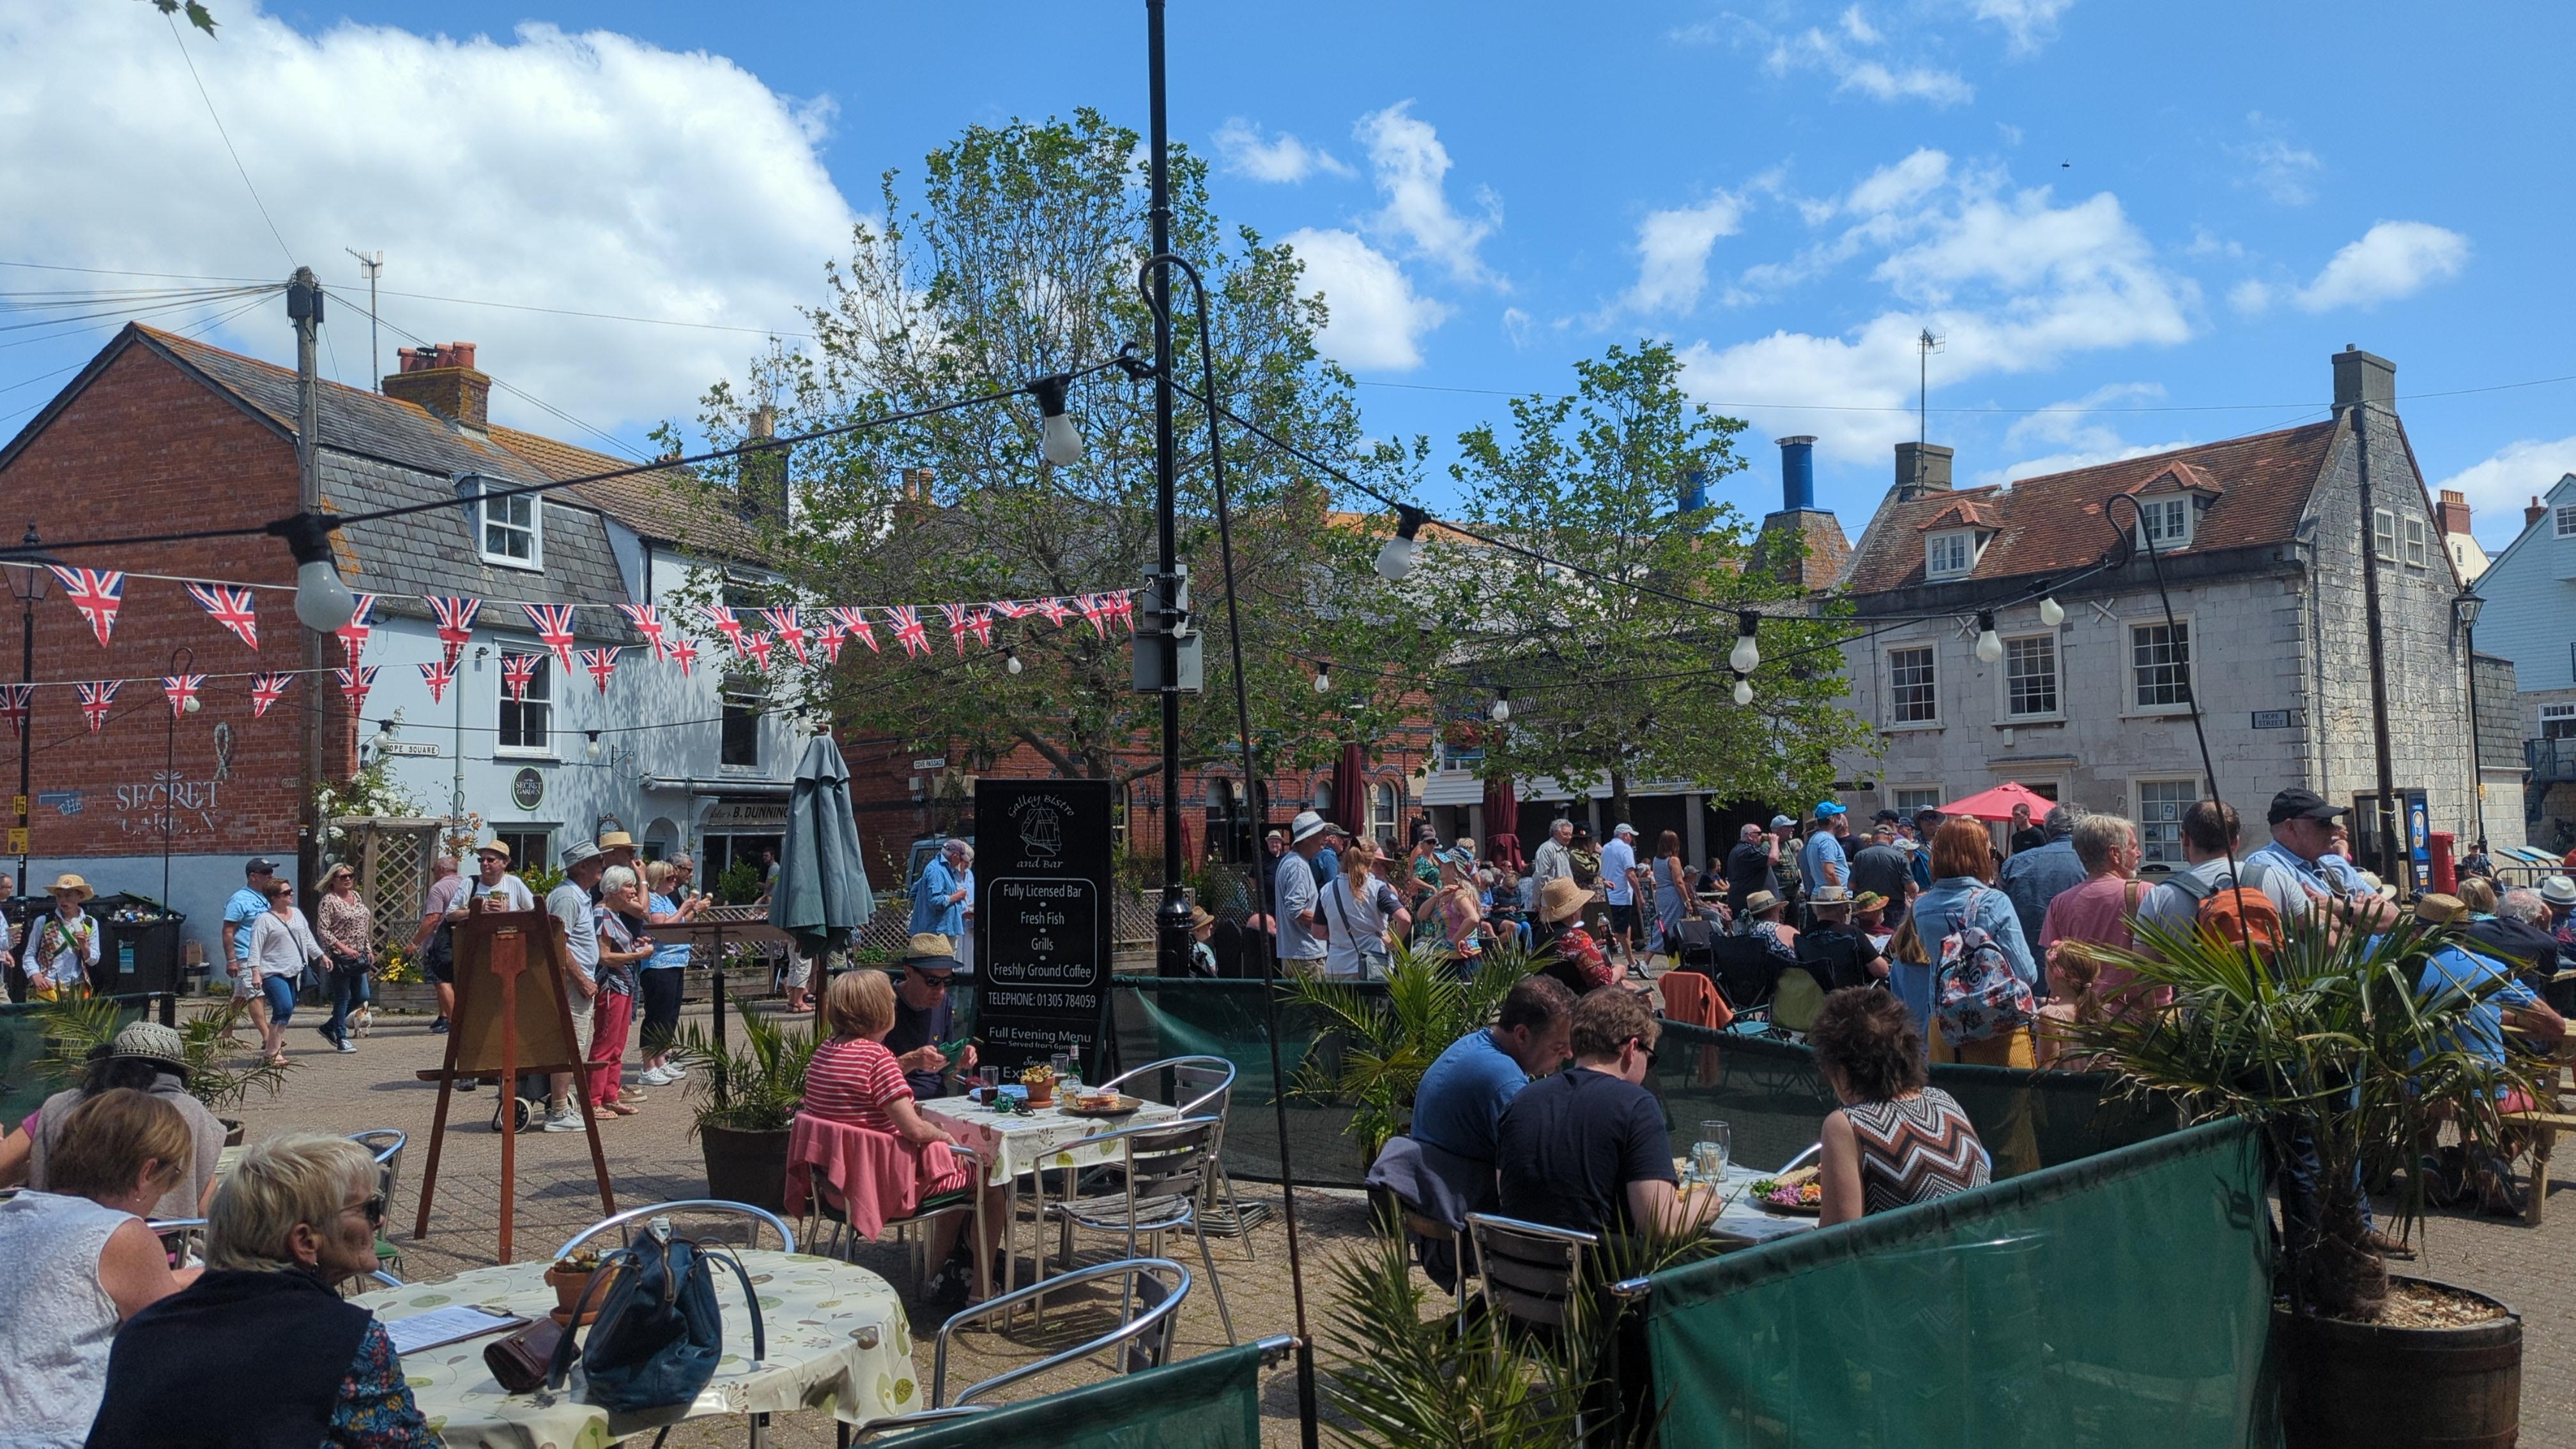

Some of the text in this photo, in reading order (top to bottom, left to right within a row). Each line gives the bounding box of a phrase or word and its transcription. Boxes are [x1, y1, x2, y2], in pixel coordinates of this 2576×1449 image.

[408, 746, 436, 754] SQUARE
[516, 781, 542, 790] SECRET
[116, 781, 223, 811] SECRET
[1008, 794, 1075, 818] Galley Bistro
[1016, 857, 1064, 868] and Bar
[1003, 884, 1082, 900] Fully Licensed Bar
[1020, 911, 1064, 925] Fresh Fish
[1031, 937, 1054, 951] Grills
[993, 962, 1091, 979] Freshly Ground Coffee
[988, 992, 1096, 1008] TELEPHONE: 01305 784059
[989, 1027, 1091, 1043] Full Evening Menu
[1008, 1040, 1034, 1048] Served
[1054, 1043, 1071, 1051] 6pm
